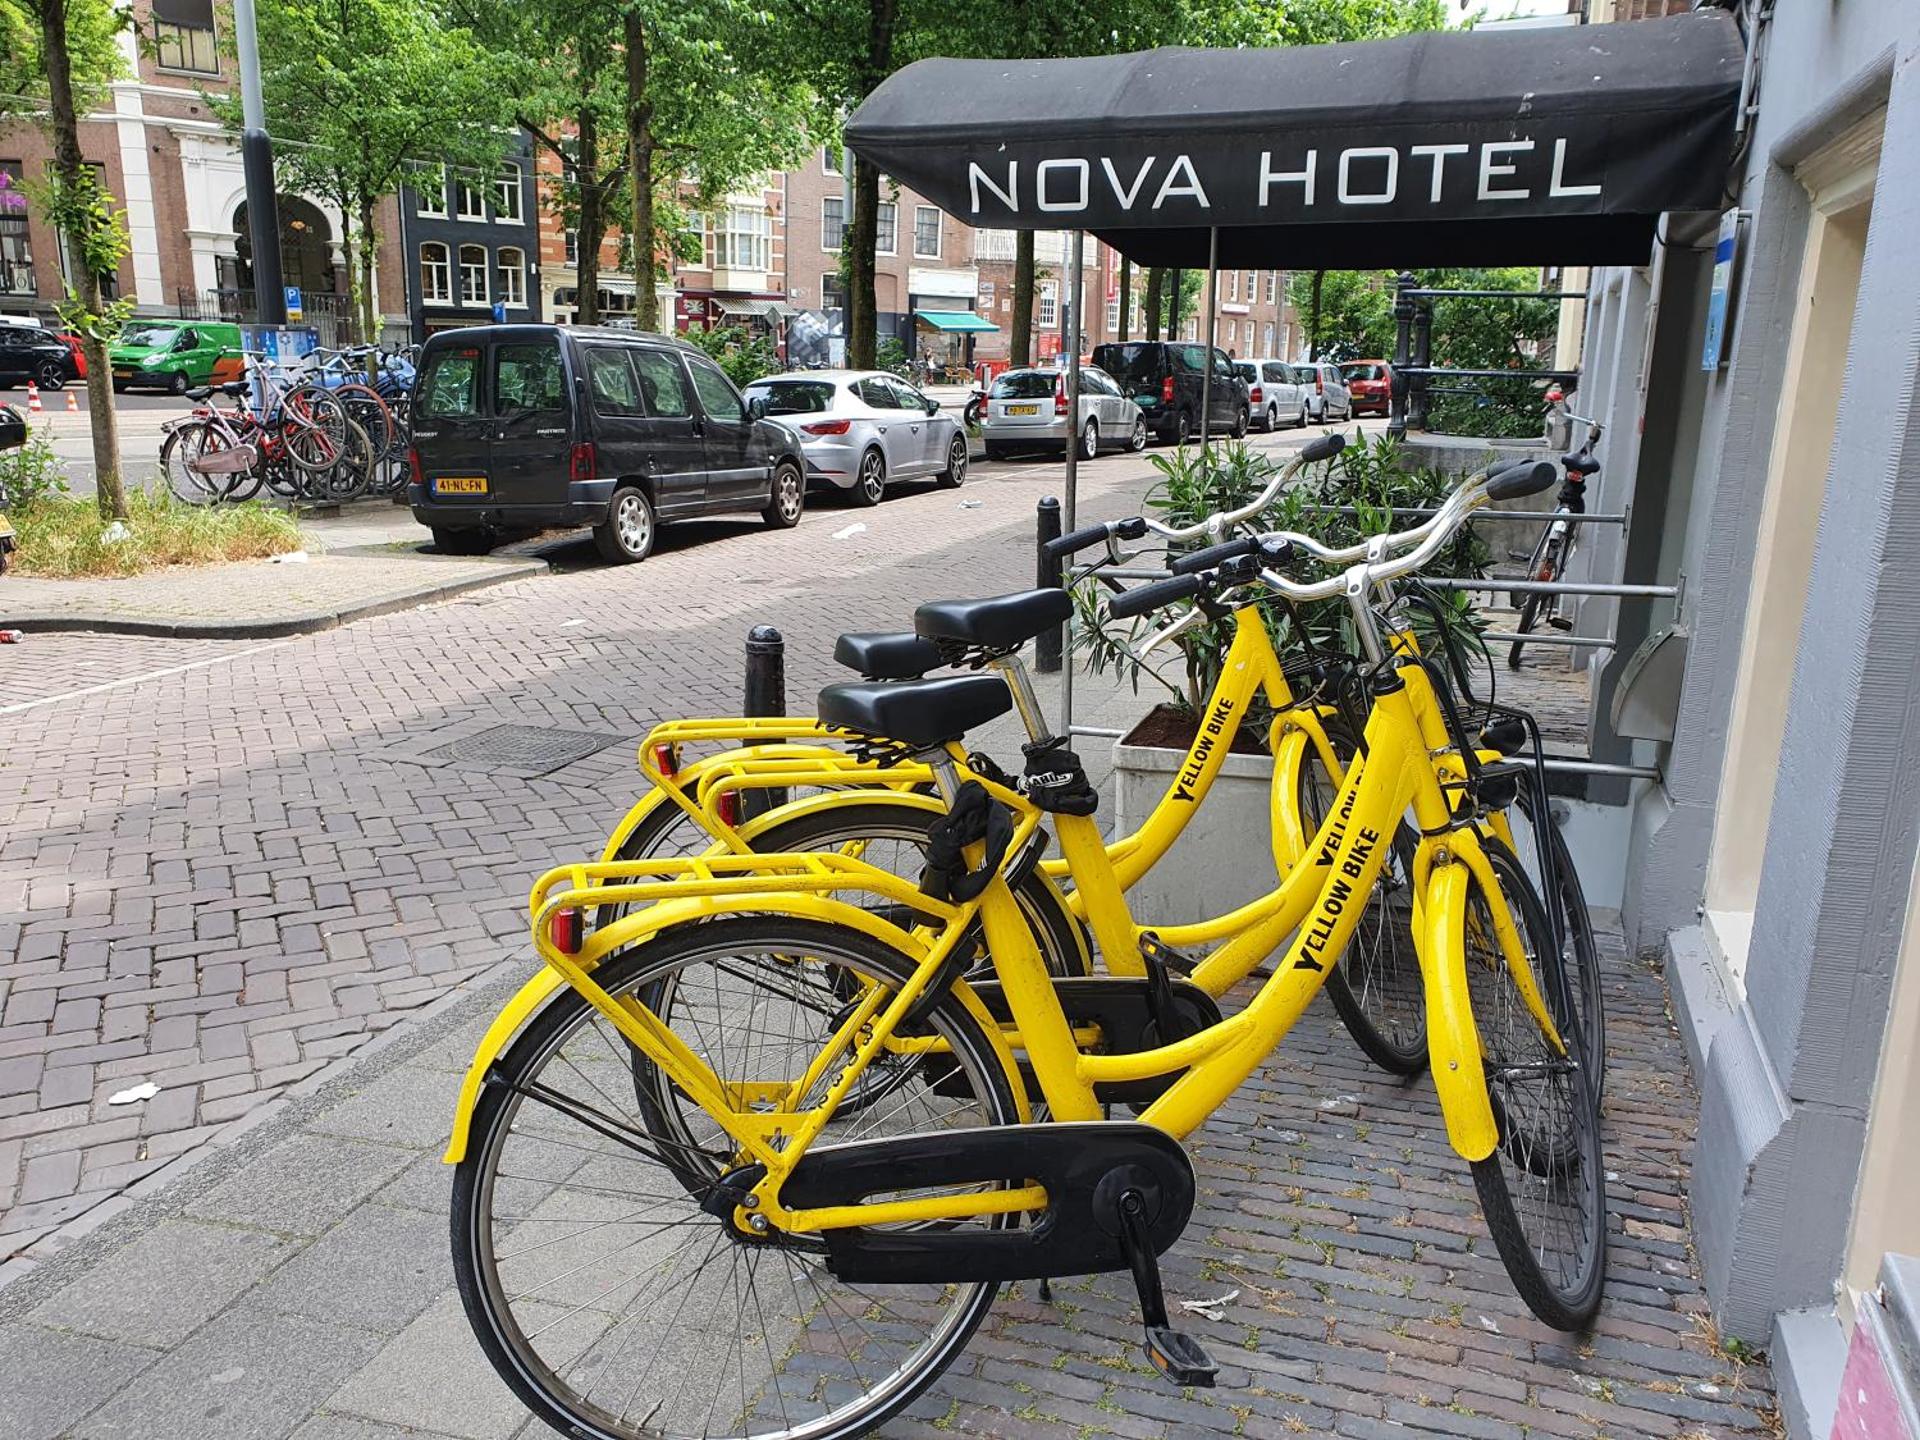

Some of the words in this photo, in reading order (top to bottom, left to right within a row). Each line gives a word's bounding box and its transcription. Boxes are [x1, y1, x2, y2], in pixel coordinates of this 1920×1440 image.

[967, 154, 1211, 214] NOVA
[1258, 138, 1602, 207] HOTEL
[439, 479, 482, 492] 41-NL-FN
[1032, 772, 1067, 787] ABUS
[1172, 736, 1215, 803] YELLOW
[1207, 697, 1234, 735] BIKE
[1292, 879, 1352, 974] YELLOW
[1341, 826, 1380, 881] BIKE
